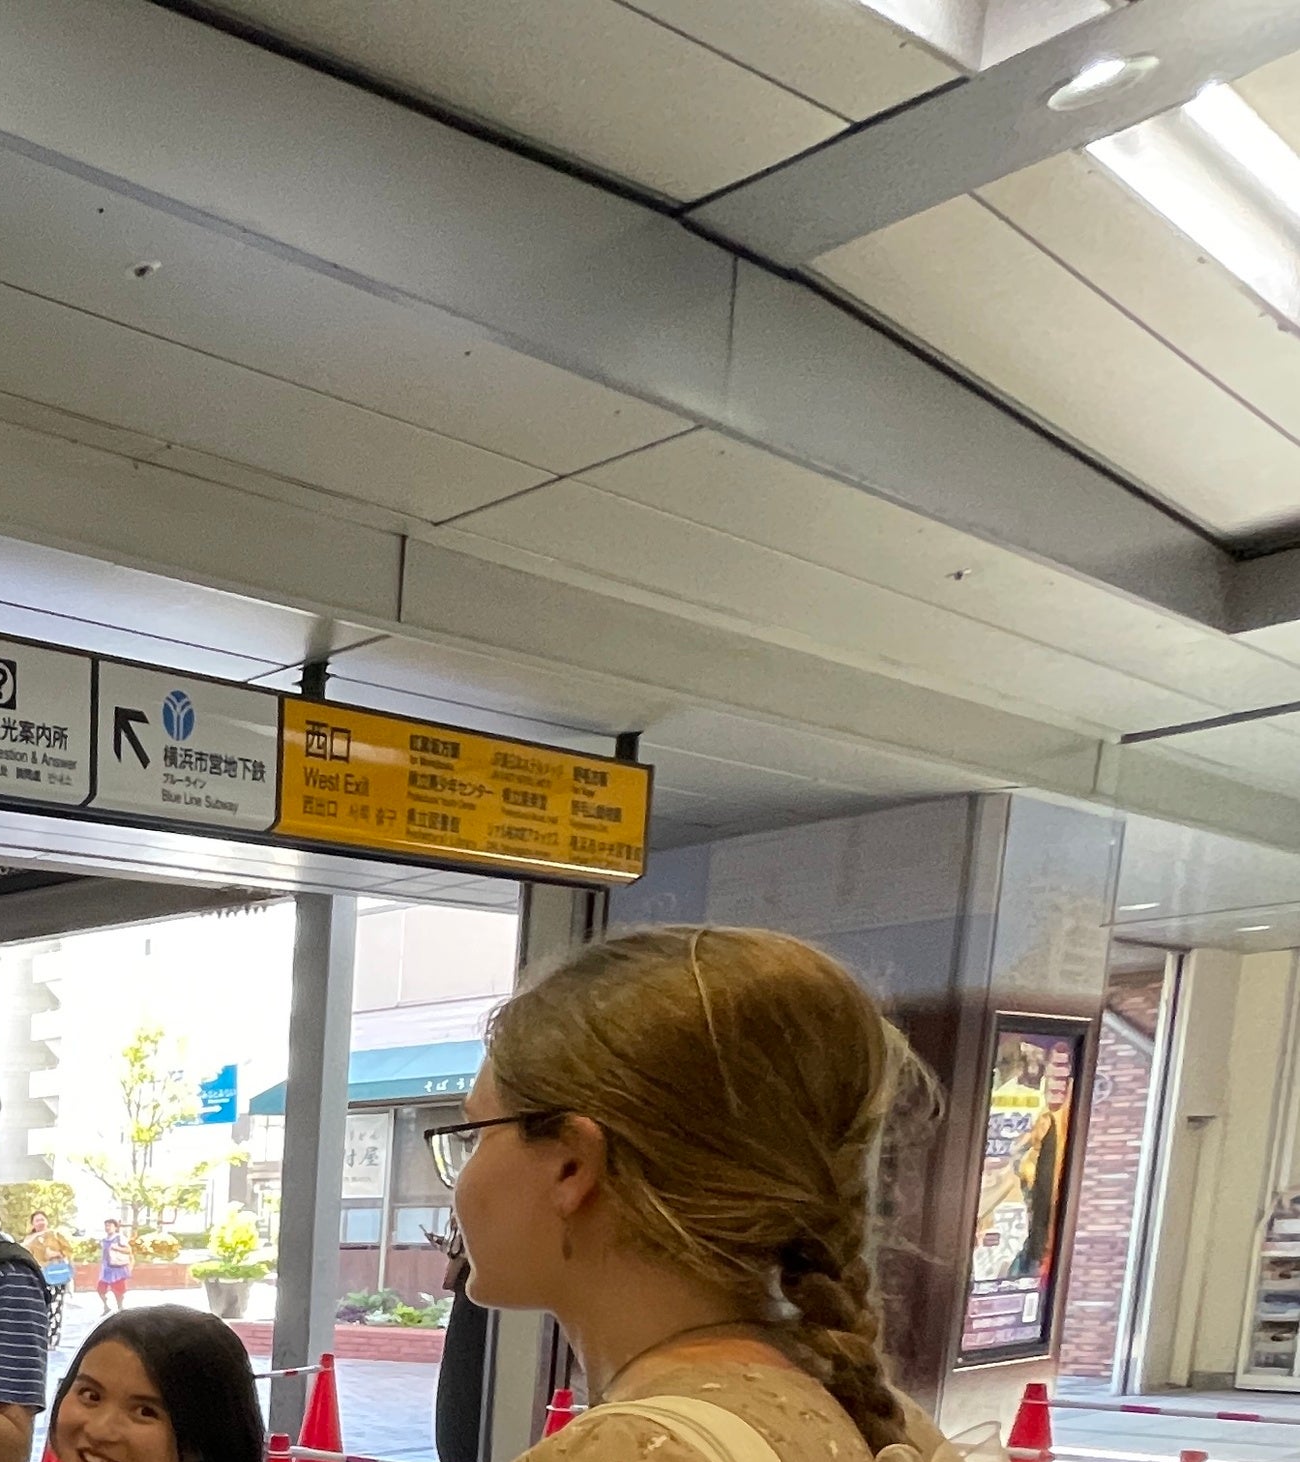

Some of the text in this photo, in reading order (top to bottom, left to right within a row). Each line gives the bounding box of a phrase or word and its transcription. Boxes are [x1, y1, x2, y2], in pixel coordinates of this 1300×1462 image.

[305, 720, 351, 764] 西口
[163, 744, 266, 783] 横浜市営地下鉄
[303, 766, 370, 797] West Exit
[161, 788, 240, 816] Blue Line Subway
